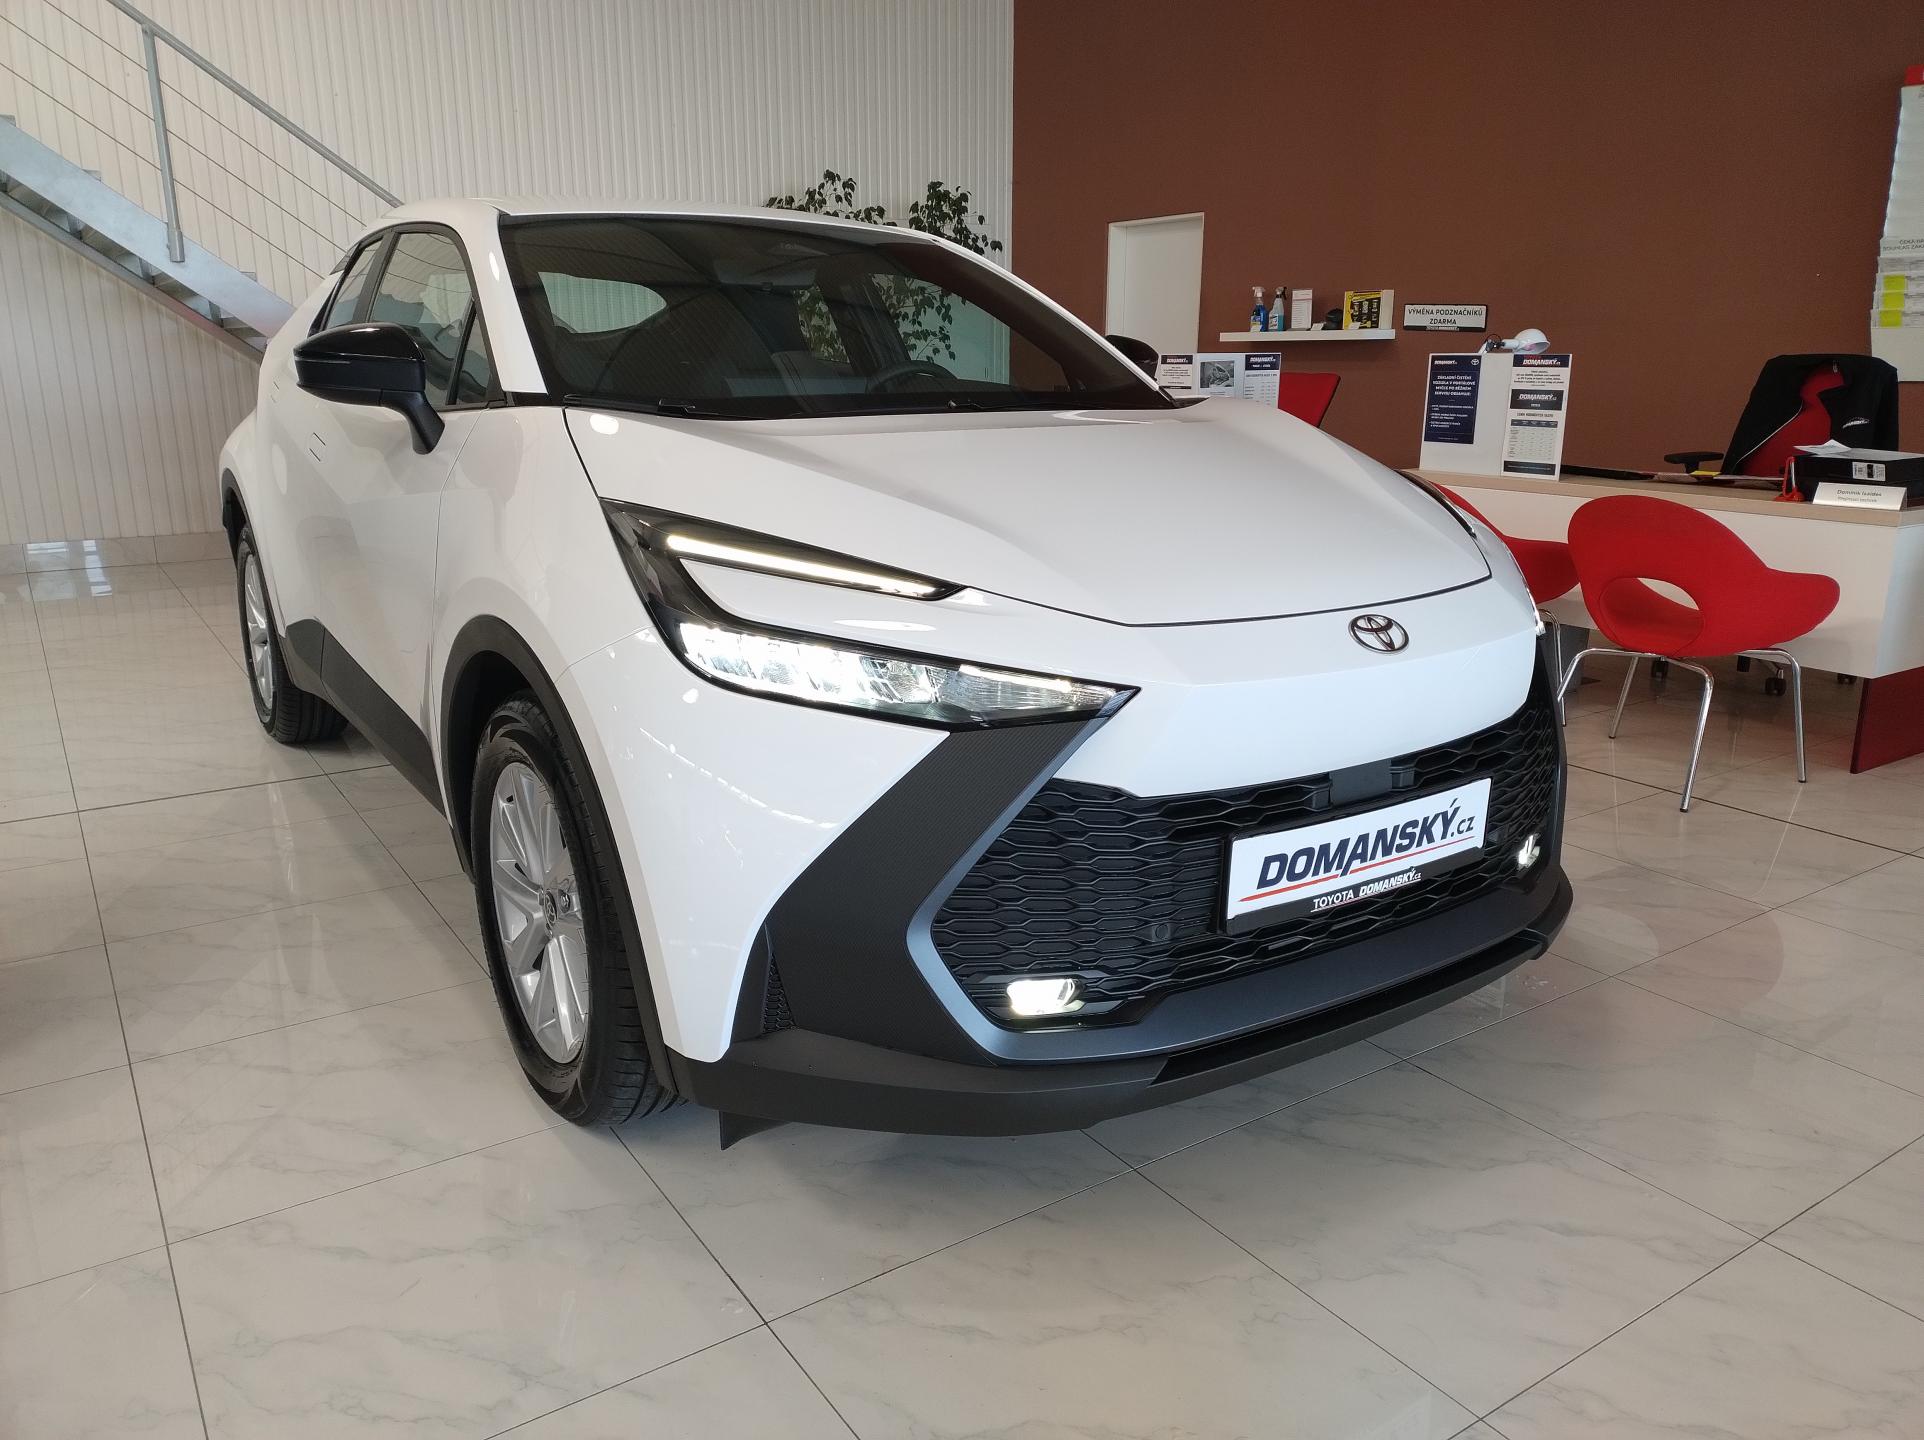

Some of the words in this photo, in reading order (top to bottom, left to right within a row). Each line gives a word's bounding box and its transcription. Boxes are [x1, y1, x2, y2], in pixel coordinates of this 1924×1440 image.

[1408, 307, 1435, 315] VÝMĚNA
[1436, 307, 1483, 316] PODZNAČNÍKŮ
[1313, 889, 1354, 910] TOYOTA
